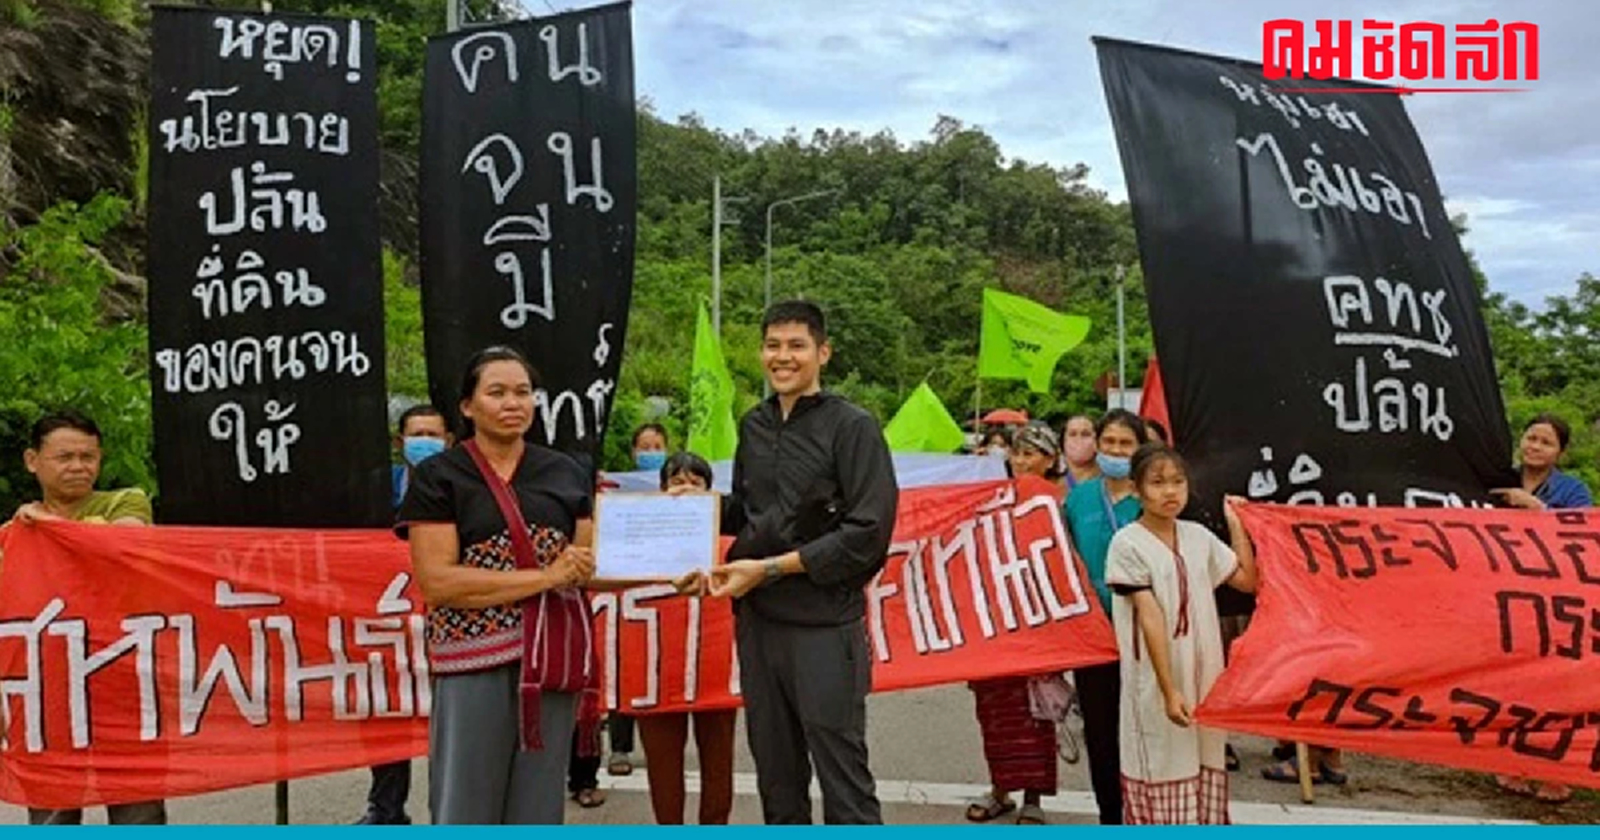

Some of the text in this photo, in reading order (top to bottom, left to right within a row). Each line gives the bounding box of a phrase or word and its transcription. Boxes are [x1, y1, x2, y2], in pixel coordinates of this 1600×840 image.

[213, 16, 361, 83] หยุด!
[451, 22, 602, 93] คน
[159, 86, 350, 156] นโยบาย
[199, 161, 327, 235] ปล้น
[461, 131, 614, 213] จน
[1235, 132, 1433, 240] ไม่เอา
[192, 244, 326, 319] ที่ดิน
[483, 203, 556, 329] มี
[156, 329, 370, 393] ของคนจน
[1322, 347, 1454, 441] ปล้น
[207, 402, 301, 482] ให้
